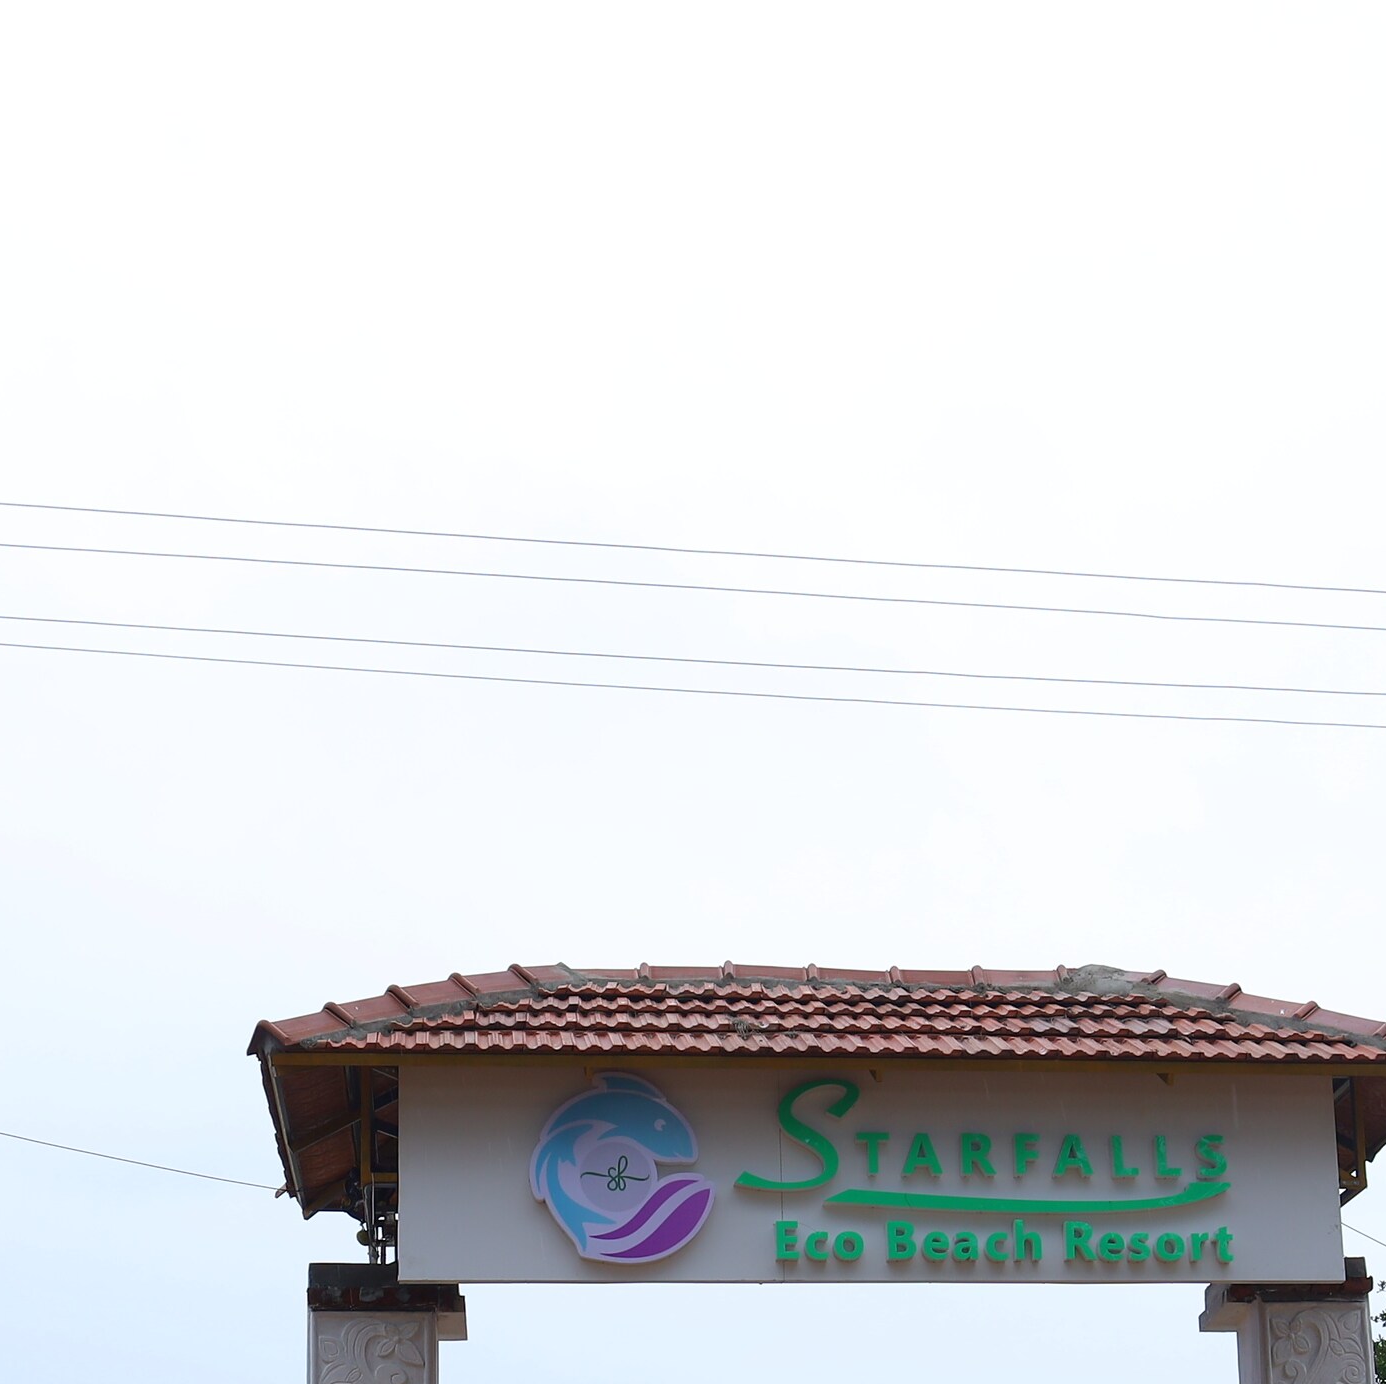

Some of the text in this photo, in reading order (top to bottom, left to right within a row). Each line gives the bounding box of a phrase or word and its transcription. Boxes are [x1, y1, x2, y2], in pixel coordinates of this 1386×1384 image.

[734, 1078, 1228, 1191] STARFALLS
[774, 1218, 1234, 1263] Eco Beach Resort
